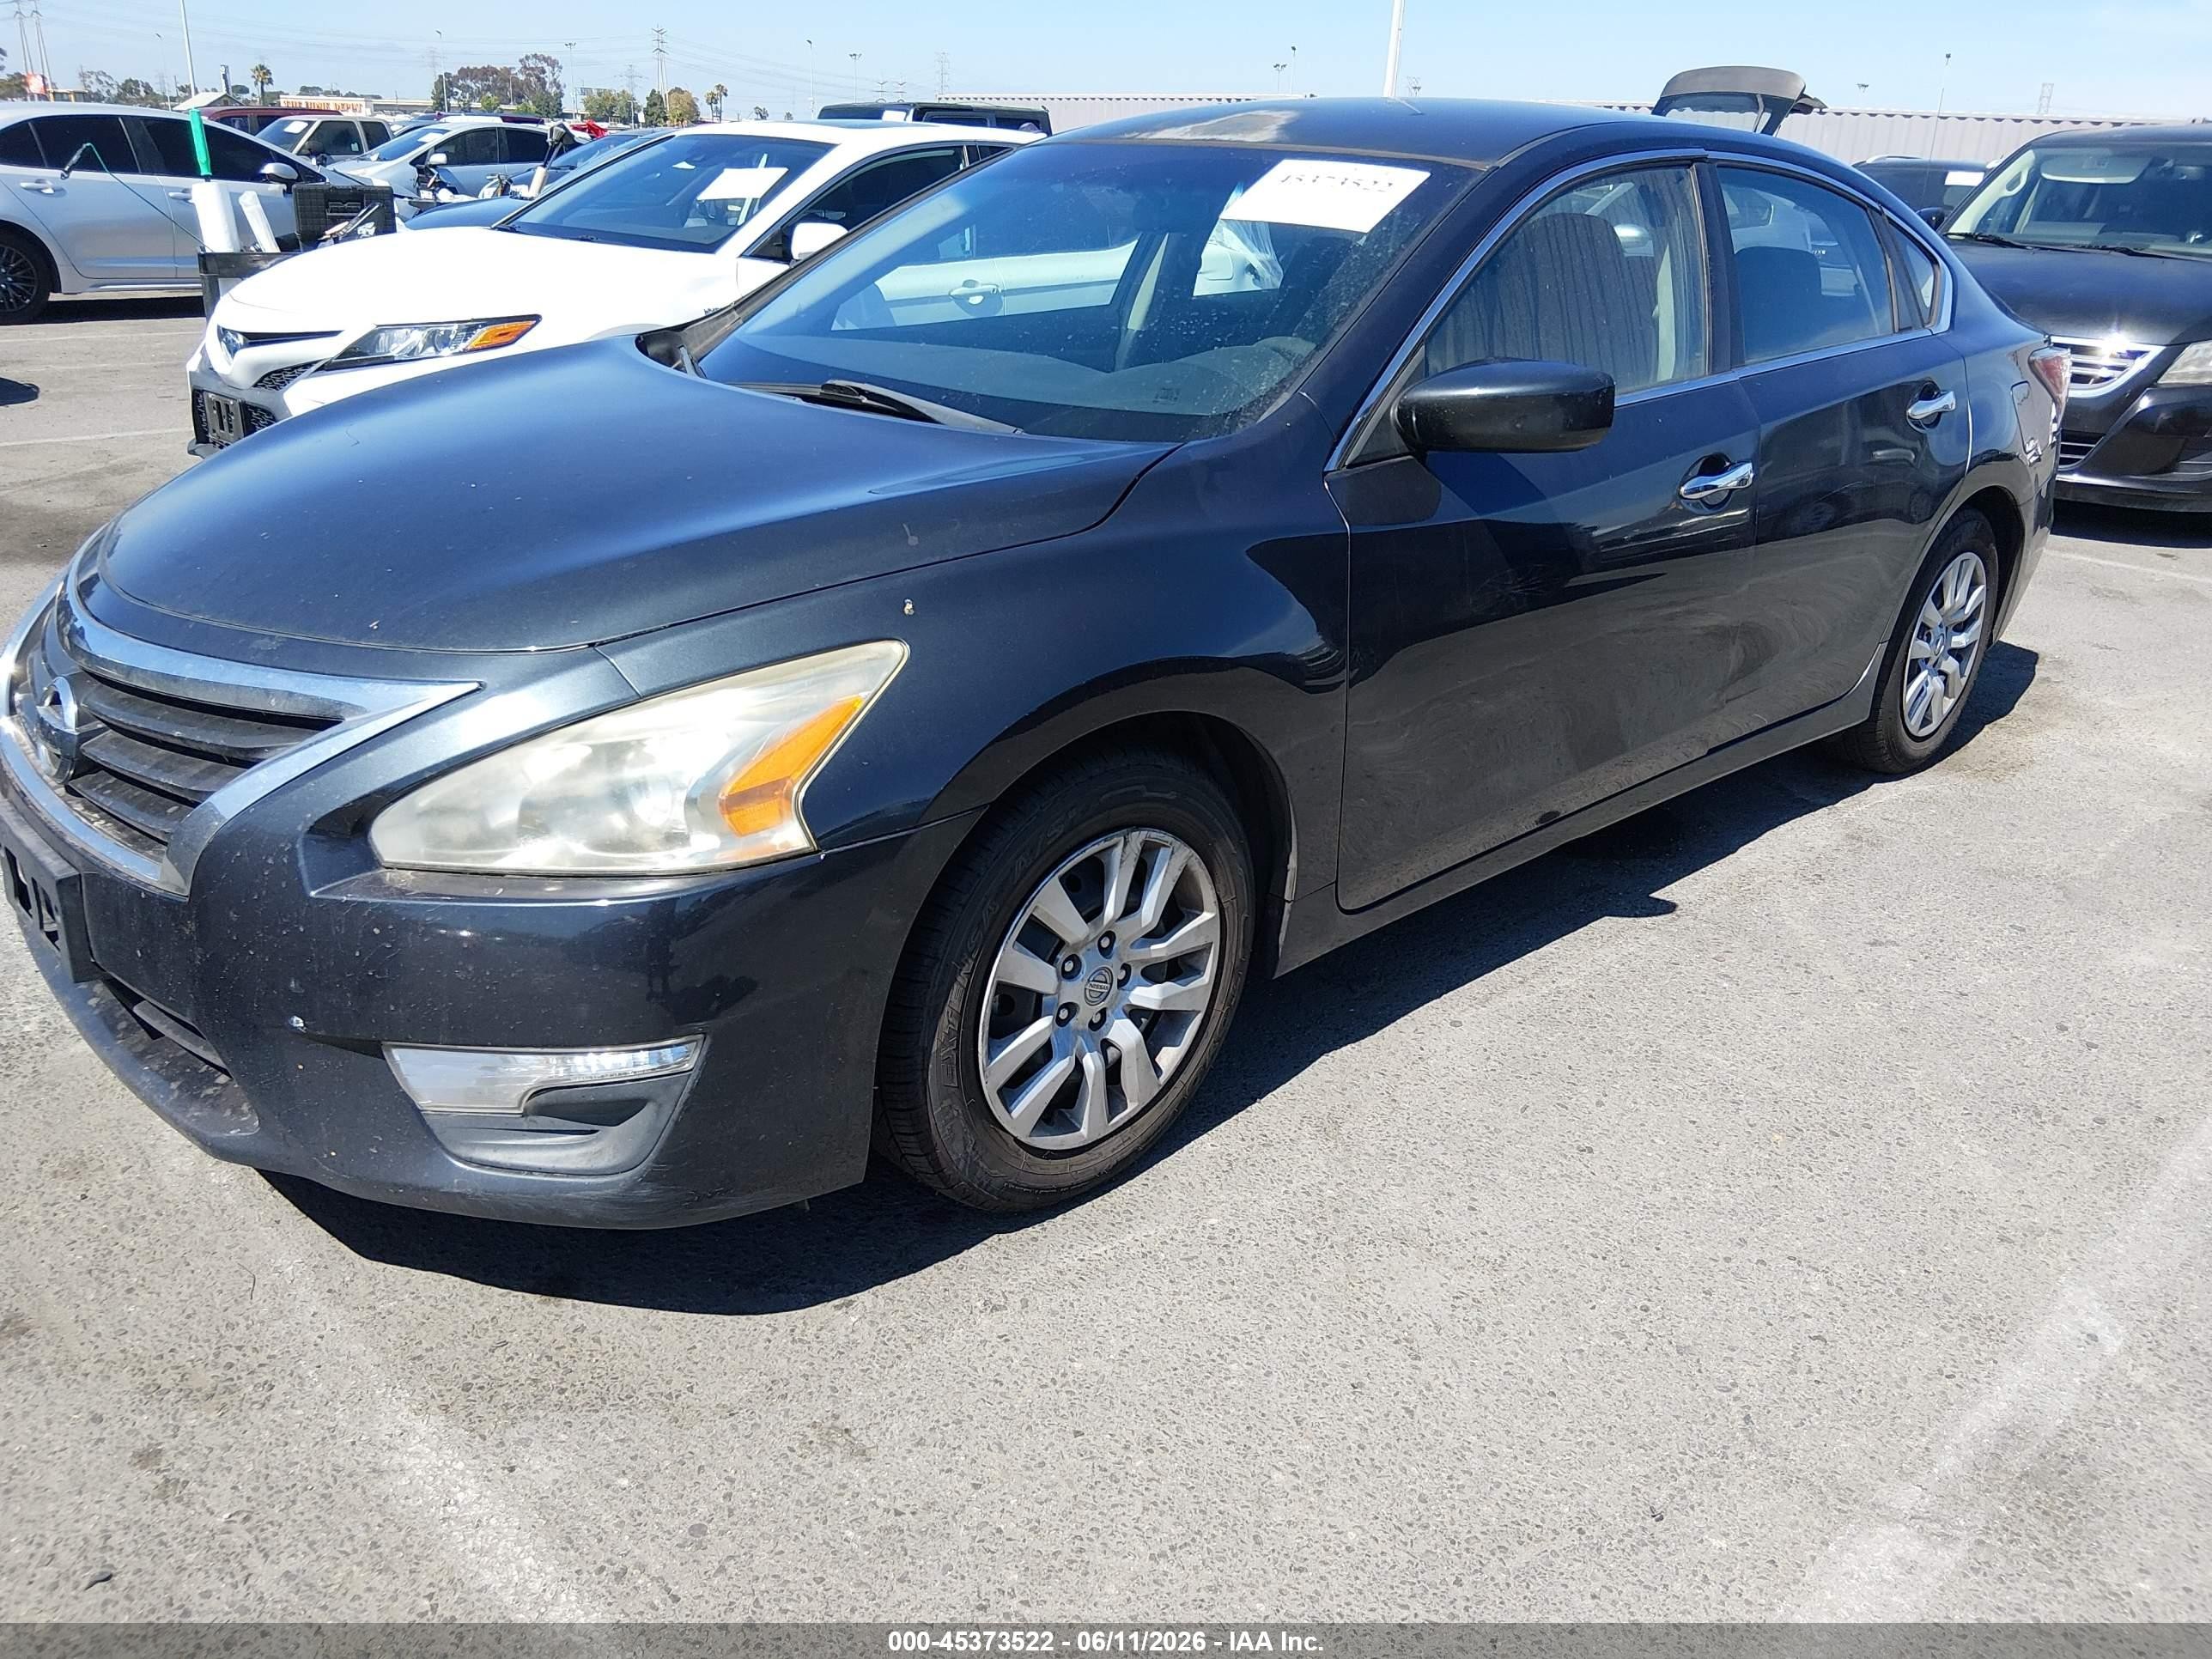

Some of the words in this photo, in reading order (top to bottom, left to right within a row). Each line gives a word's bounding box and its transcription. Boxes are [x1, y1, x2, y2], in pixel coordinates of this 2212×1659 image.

[283, 100, 302, 108] THE
[304, 100, 331, 111] HOME
[334, 102, 364, 113] DEPOT
[1089, 982, 1109, 991] NISSAN
